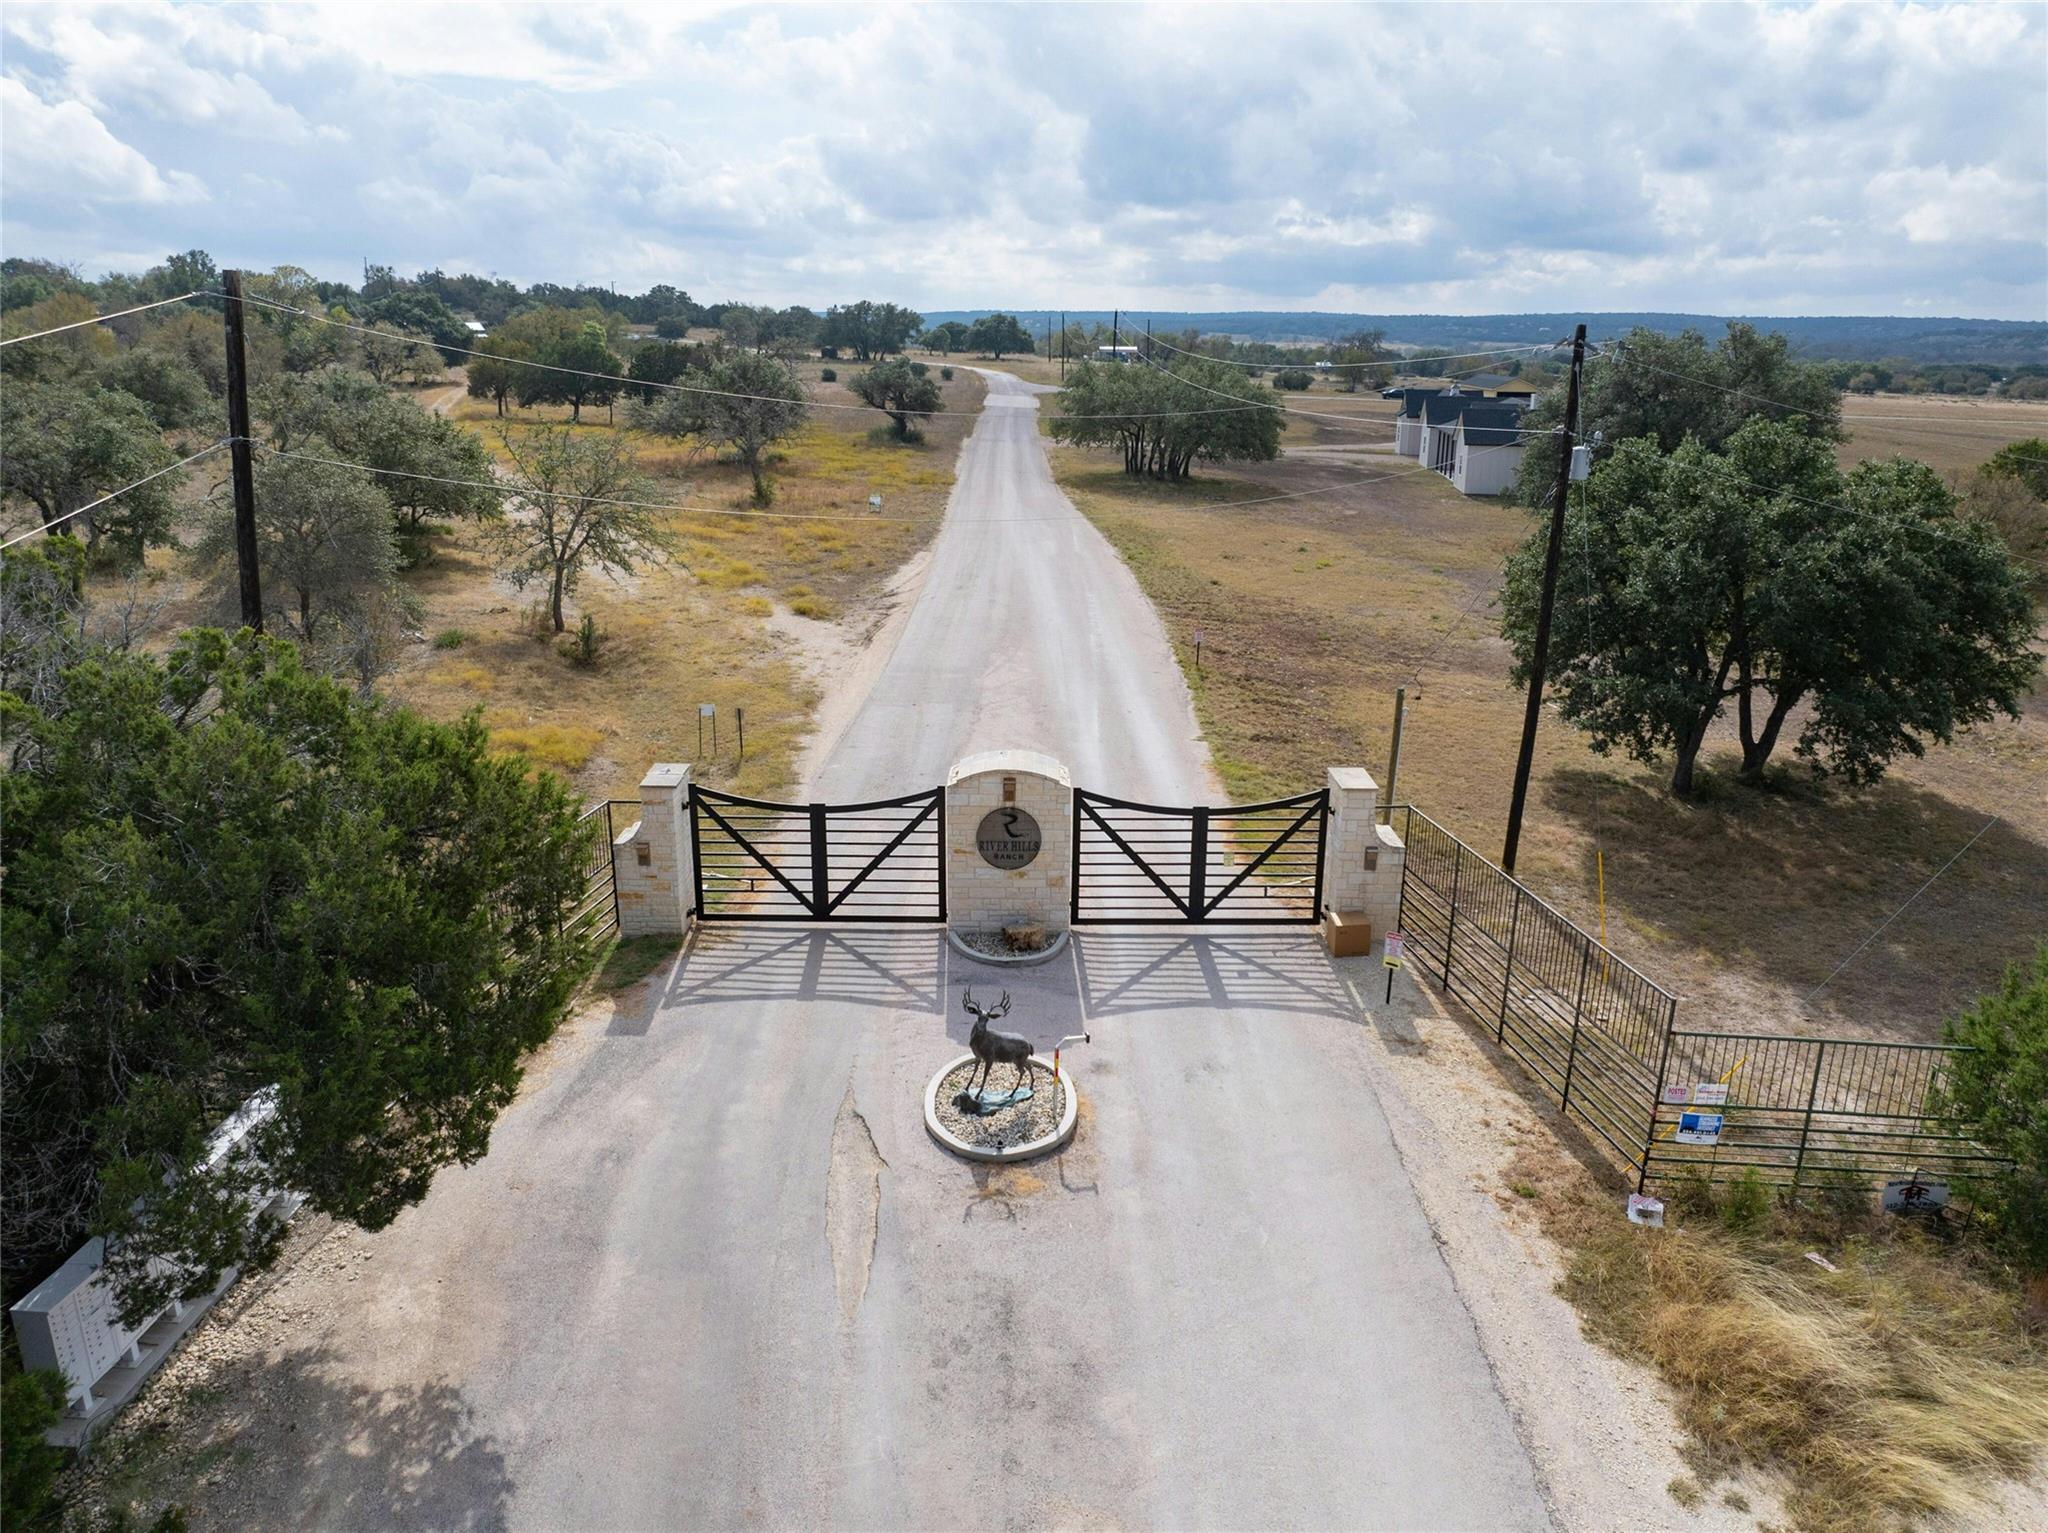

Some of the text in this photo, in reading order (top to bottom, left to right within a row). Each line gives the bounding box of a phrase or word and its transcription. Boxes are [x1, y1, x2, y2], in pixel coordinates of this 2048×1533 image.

[979, 841, 1040, 852] RIVER HILLS
[1668, 1087, 1687, 1095] POSTED
